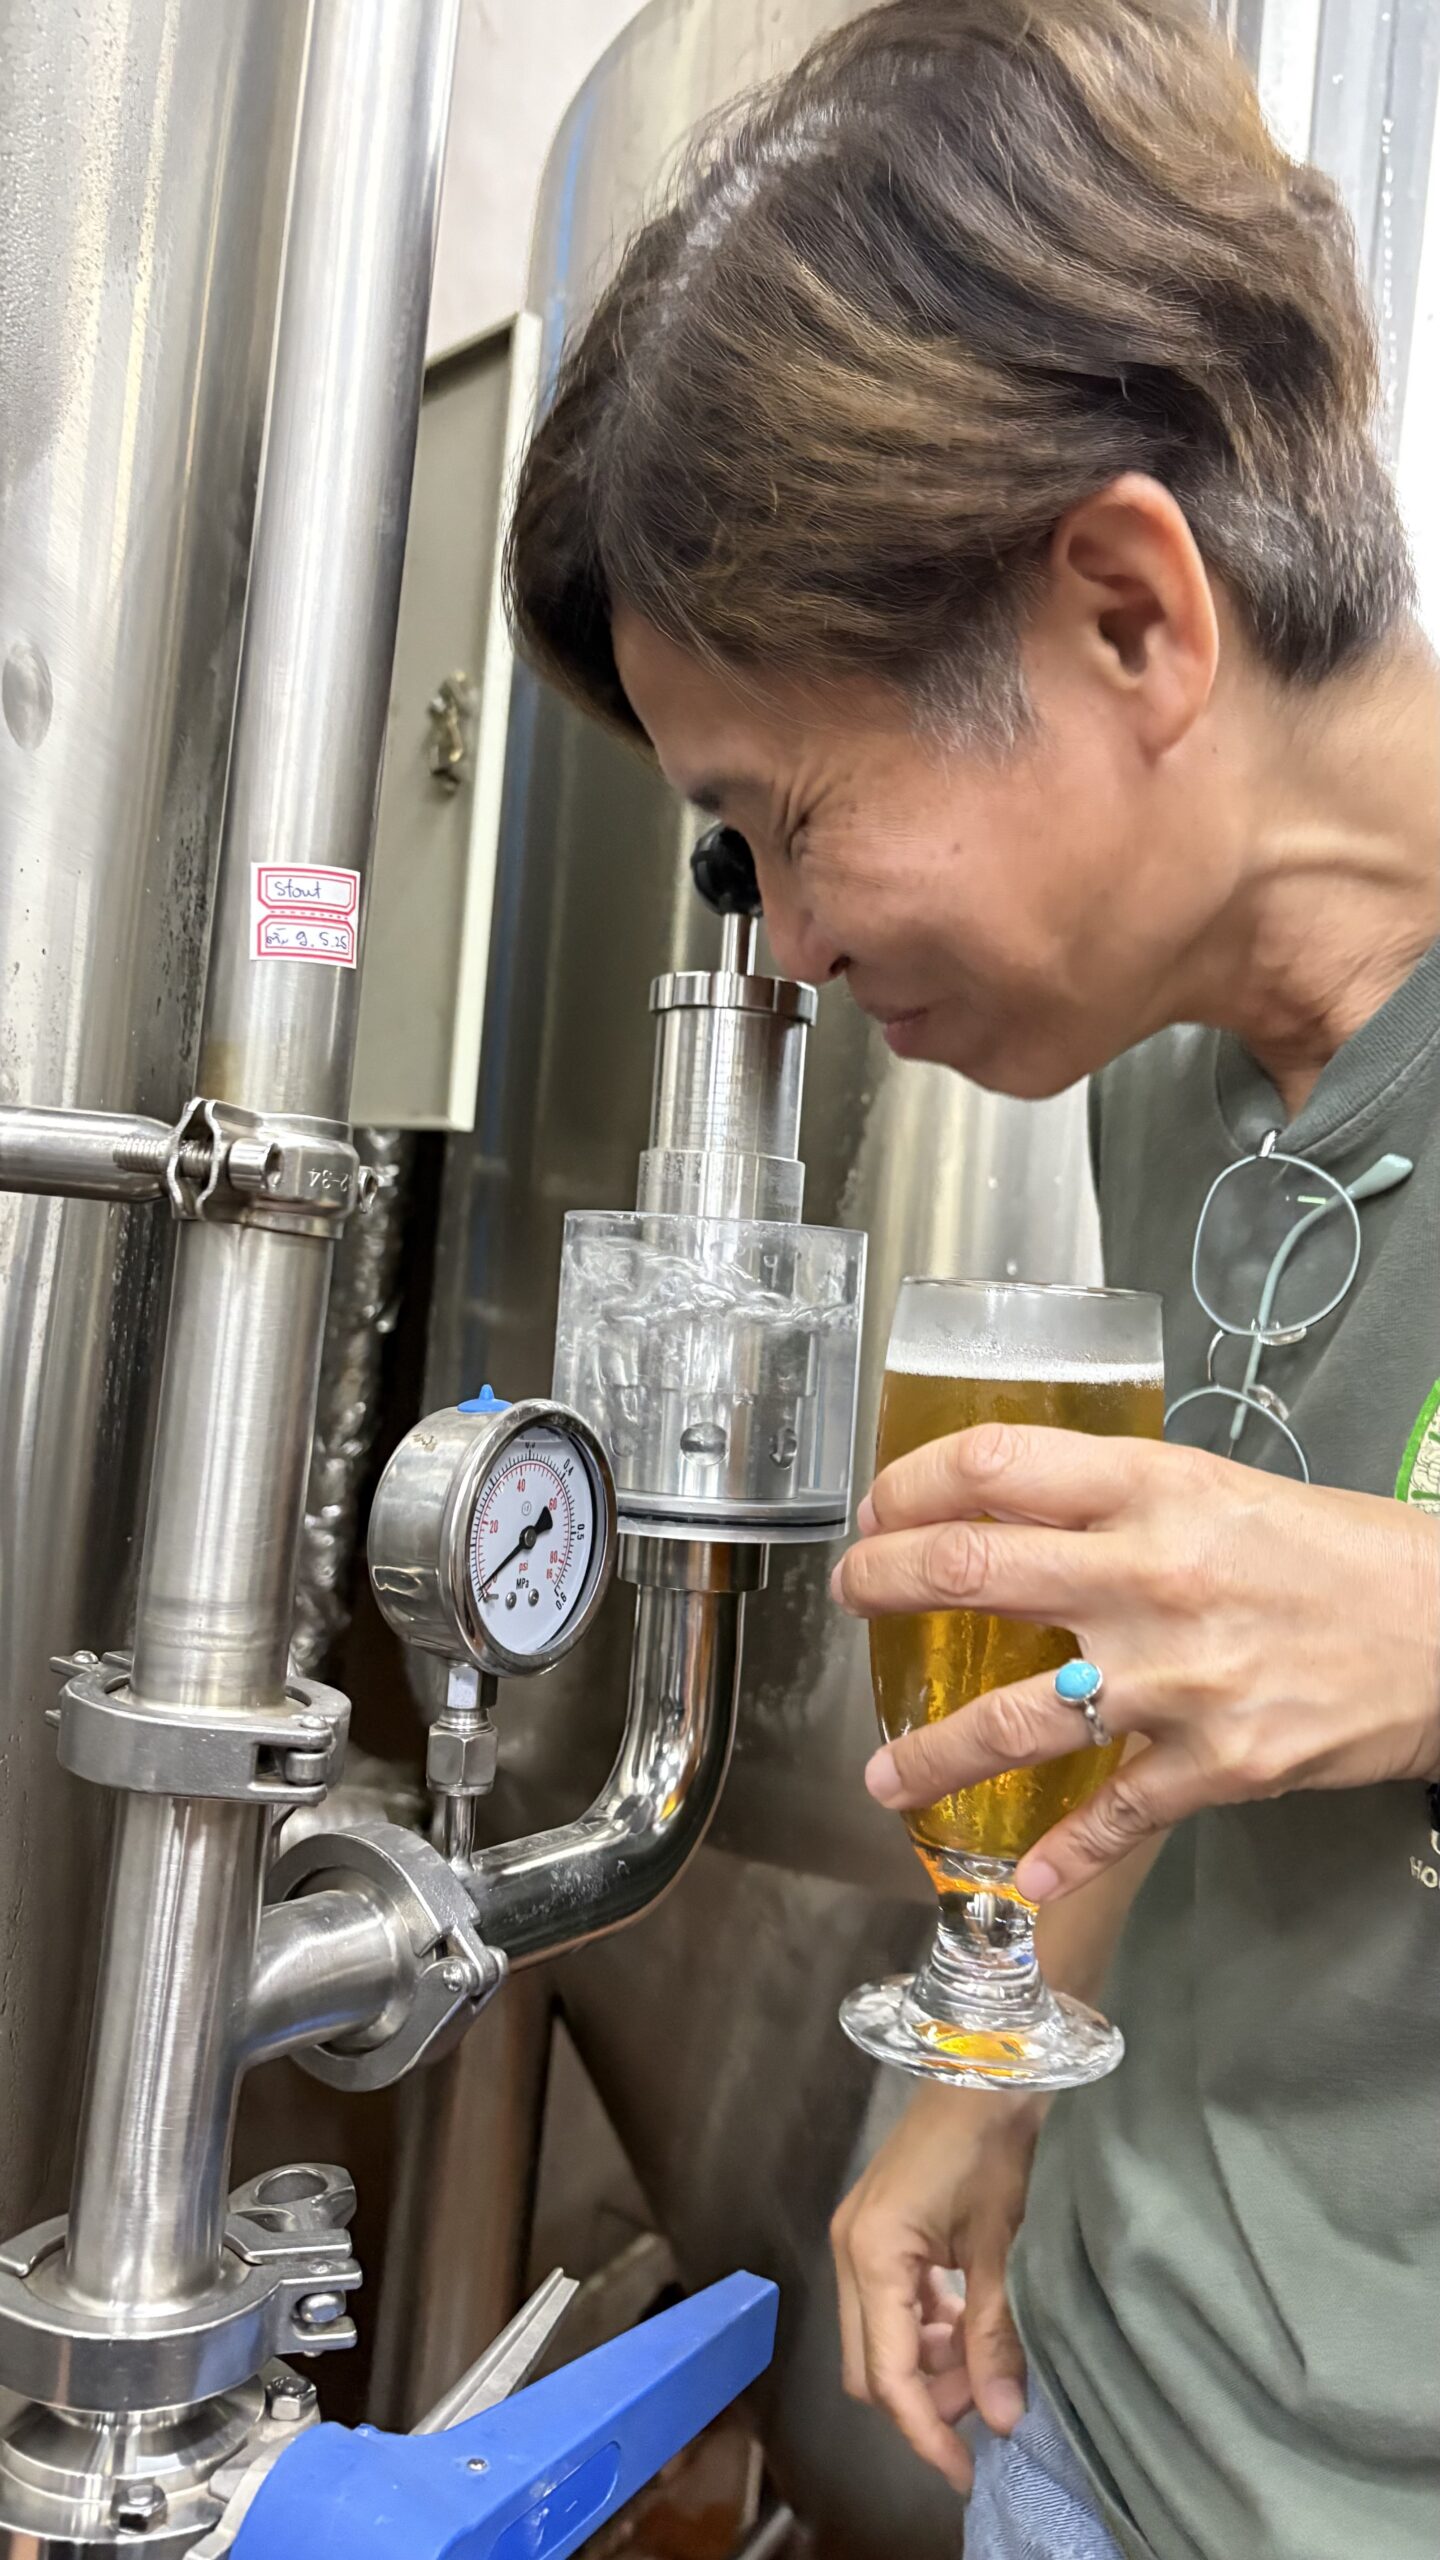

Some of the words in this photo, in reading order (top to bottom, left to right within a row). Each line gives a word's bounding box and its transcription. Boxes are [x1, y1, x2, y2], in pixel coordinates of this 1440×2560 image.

[275, 878, 322, 899] Stout
[563, 1458, 574, 1477] 0.4
[517, 1478, 526, 1493] 40
[548, 1497, 558, 1511] 60
[489, 1519, 499, 1534] 20
[576, 1523, 586, 1541] 0.5
[549, 1550, 558, 1564] 80
[518, 1560, 529, 1575] psi
[516, 1577, 530, 1590] MPa
[555, 1592, 567, 1611] 0.6
[1409, 1855, 1440, 1889] HO
